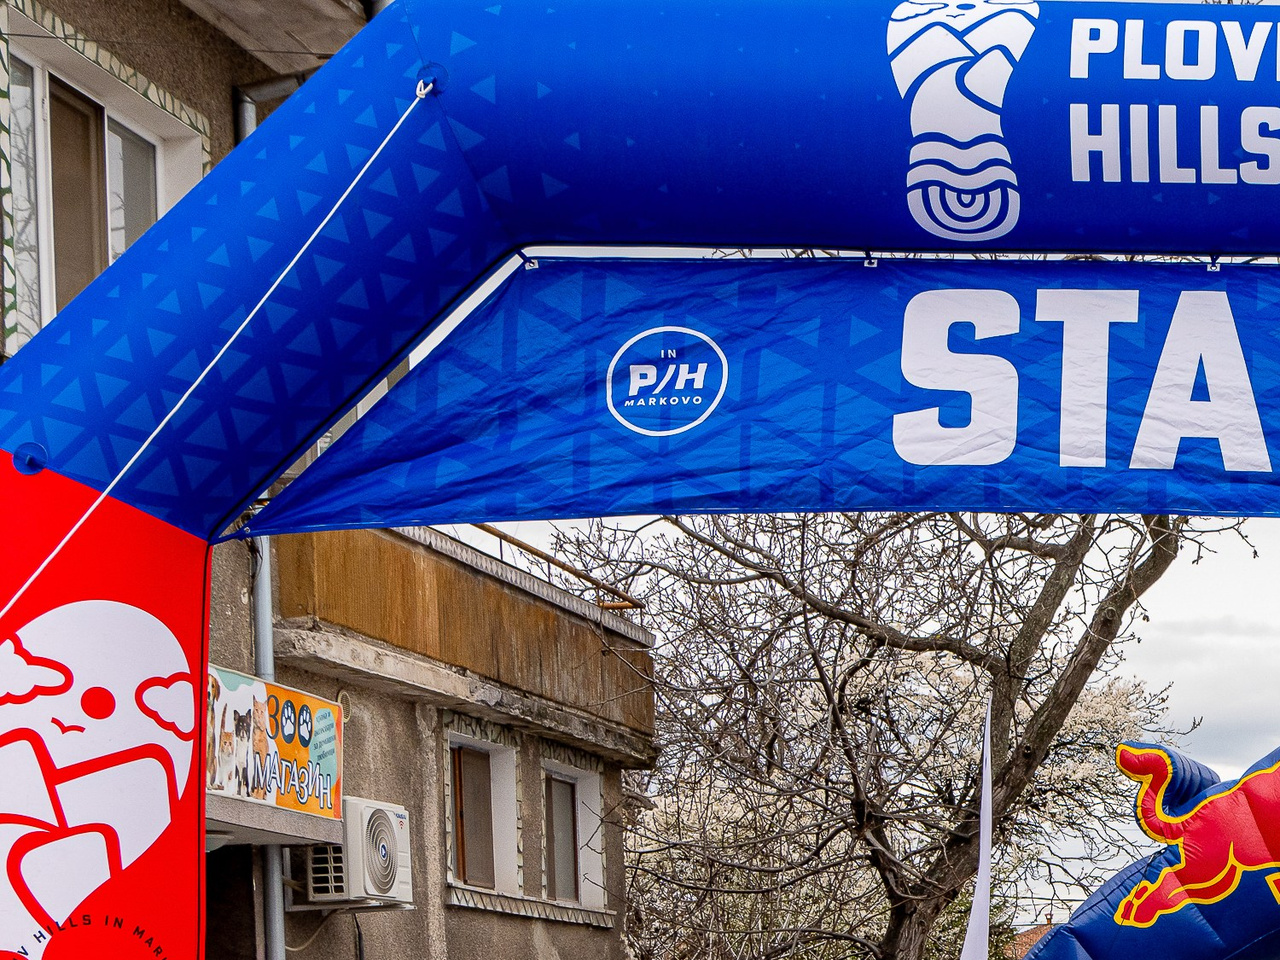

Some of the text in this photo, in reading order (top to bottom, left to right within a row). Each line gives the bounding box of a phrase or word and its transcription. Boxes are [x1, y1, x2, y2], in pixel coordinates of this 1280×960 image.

[660, 349, 677, 359] IN
[628, 363, 708, 396] P/H
[624, 396, 702, 407] MARKOVO
[254, 751, 332, 809] МАГАЗИН
[33, 914, 92, 943] HILLS
[104, 915, 124, 928] IN
